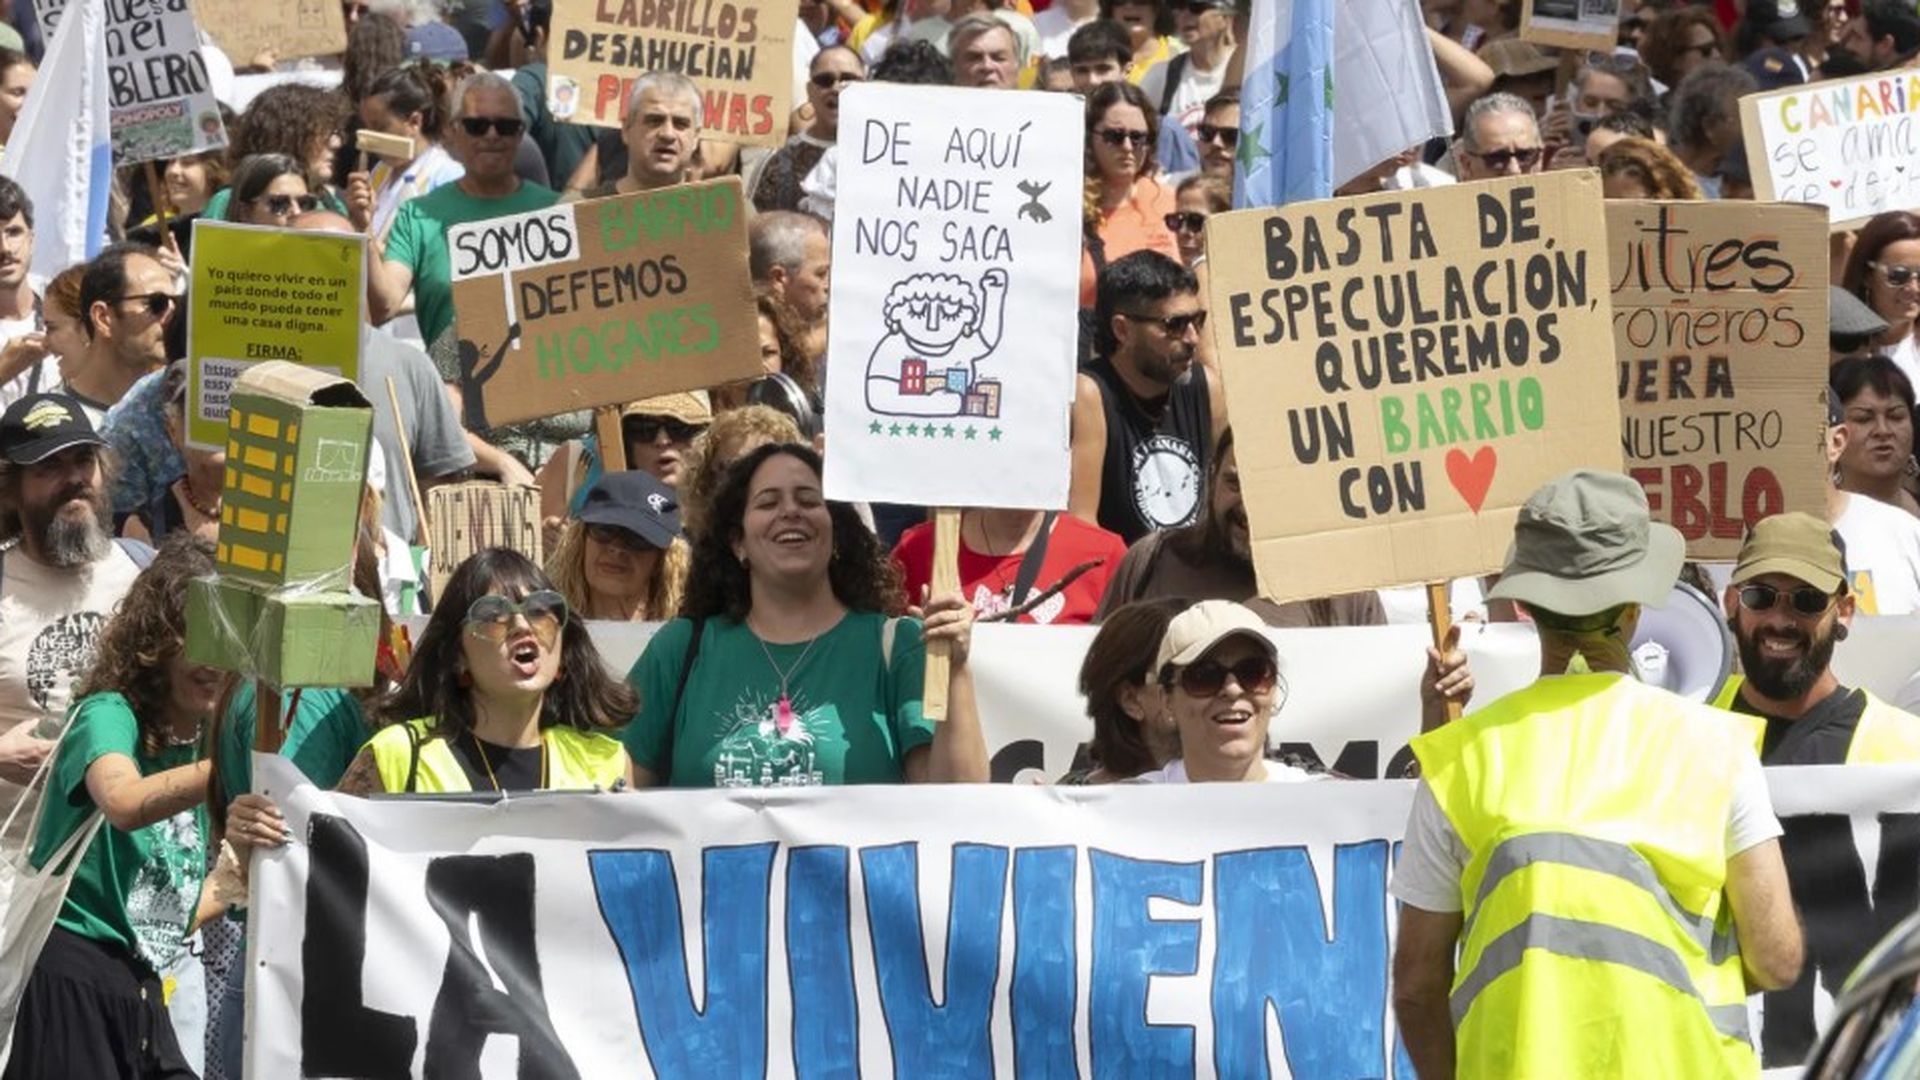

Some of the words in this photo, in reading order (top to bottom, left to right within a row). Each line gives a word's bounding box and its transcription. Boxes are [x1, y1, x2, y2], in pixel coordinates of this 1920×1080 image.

[595, 0, 759, 44] LADRILLOS
[107, 50, 209, 108] BLERO
[862, 119, 911, 166] DE
[944, 120, 1032, 170] AQUÍ
[897, 176, 993, 214] NADIE
[456, 214, 573, 276] SOMOS
[600, 182, 736, 254] BARRIO
[856, 217, 919, 262] NOS
[940, 220, 1013, 262] SACA
[1263, 202, 1438, 280] BASTA
[1476, 186, 1541, 249] DE
[208, 267, 224, 280] Yo
[227, 270, 272, 283] quiero
[275, 271, 305, 285] vivir
[308, 275, 326, 286] en
[328, 277, 347, 288] un
[245, 286, 288, 299] donde
[292, 289, 323, 301] todo
[326, 291, 339, 302] el
[520, 253, 688, 321] DEFEMOS
[1229, 237, 1598, 348] ESPECULACIÓN,
[209, 299, 257, 312] mundo
[260, 302, 302, 316] pueda
[306, 305, 344, 317] tener
[223, 314, 249, 326] una
[251, 317, 282, 329] casa
[285, 317, 328, 334] digna.
[534, 301, 721, 380] HOGARES
[1315, 312, 1562, 393] QUEREMOS
[1288, 401, 1355, 464] UN
[1380, 376, 1544, 453] BARRIO
[1621, 409, 1783, 460] NUESTRO
[1339, 461, 1426, 519] CON
[301, 813, 582, 1080] LA
[588, 839, 1398, 1080] VIVIEN
